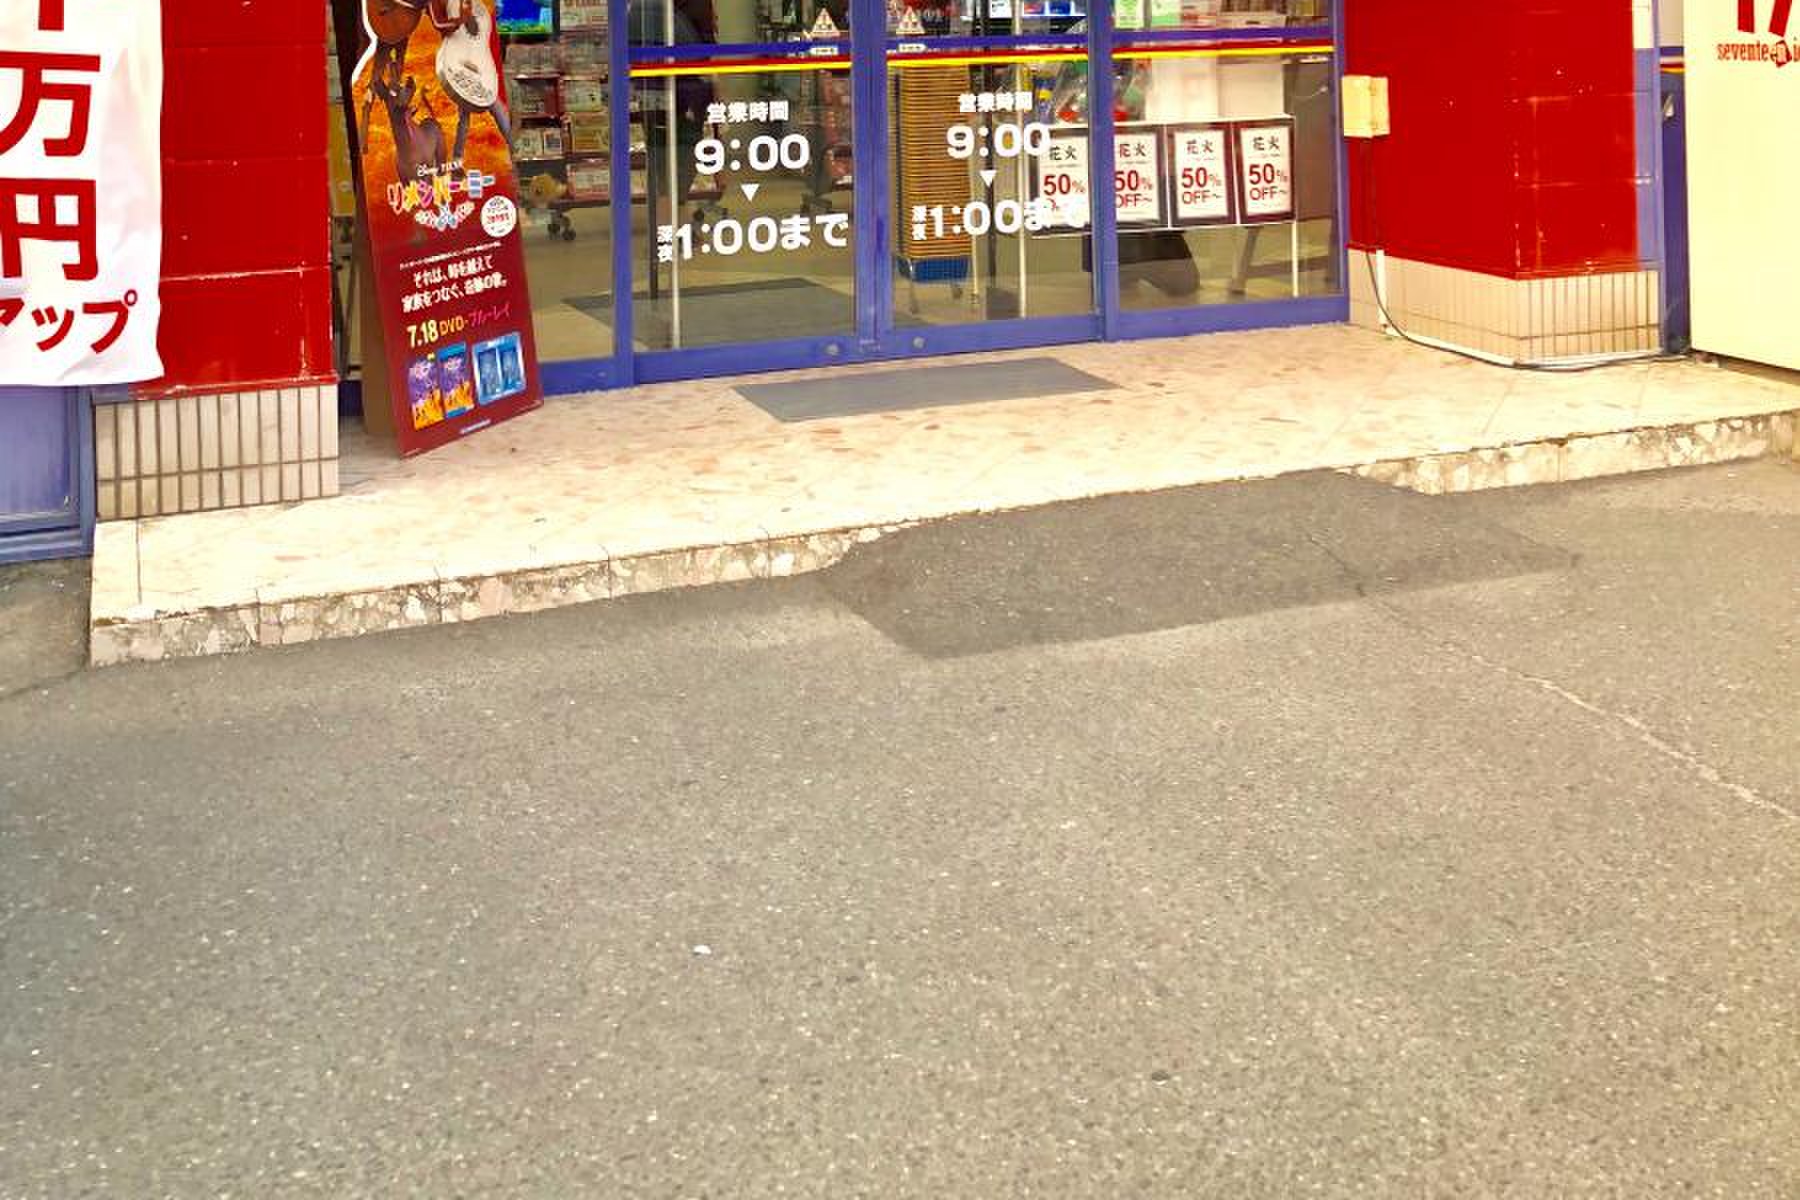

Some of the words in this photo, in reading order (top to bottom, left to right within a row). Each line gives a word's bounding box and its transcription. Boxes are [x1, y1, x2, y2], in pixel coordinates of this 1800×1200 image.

[706, 100, 789, 124] 営業時間
[958, 91, 1033, 112] 営業時間
[946, 122, 1051, 160] 9:00
[1049, 145, 1078, 161] 花火
[1118, 143, 1148, 158] 花火
[1186, 139, 1213, 155] 花火
[1253, 135, 1280, 151] 花火
[694, 133, 810, 175] 9:00
[930, 197, 1089, 237] 1:00ま
[676, 213, 849, 260] 1:00まで
[406, 319, 439, 348] 7.18
